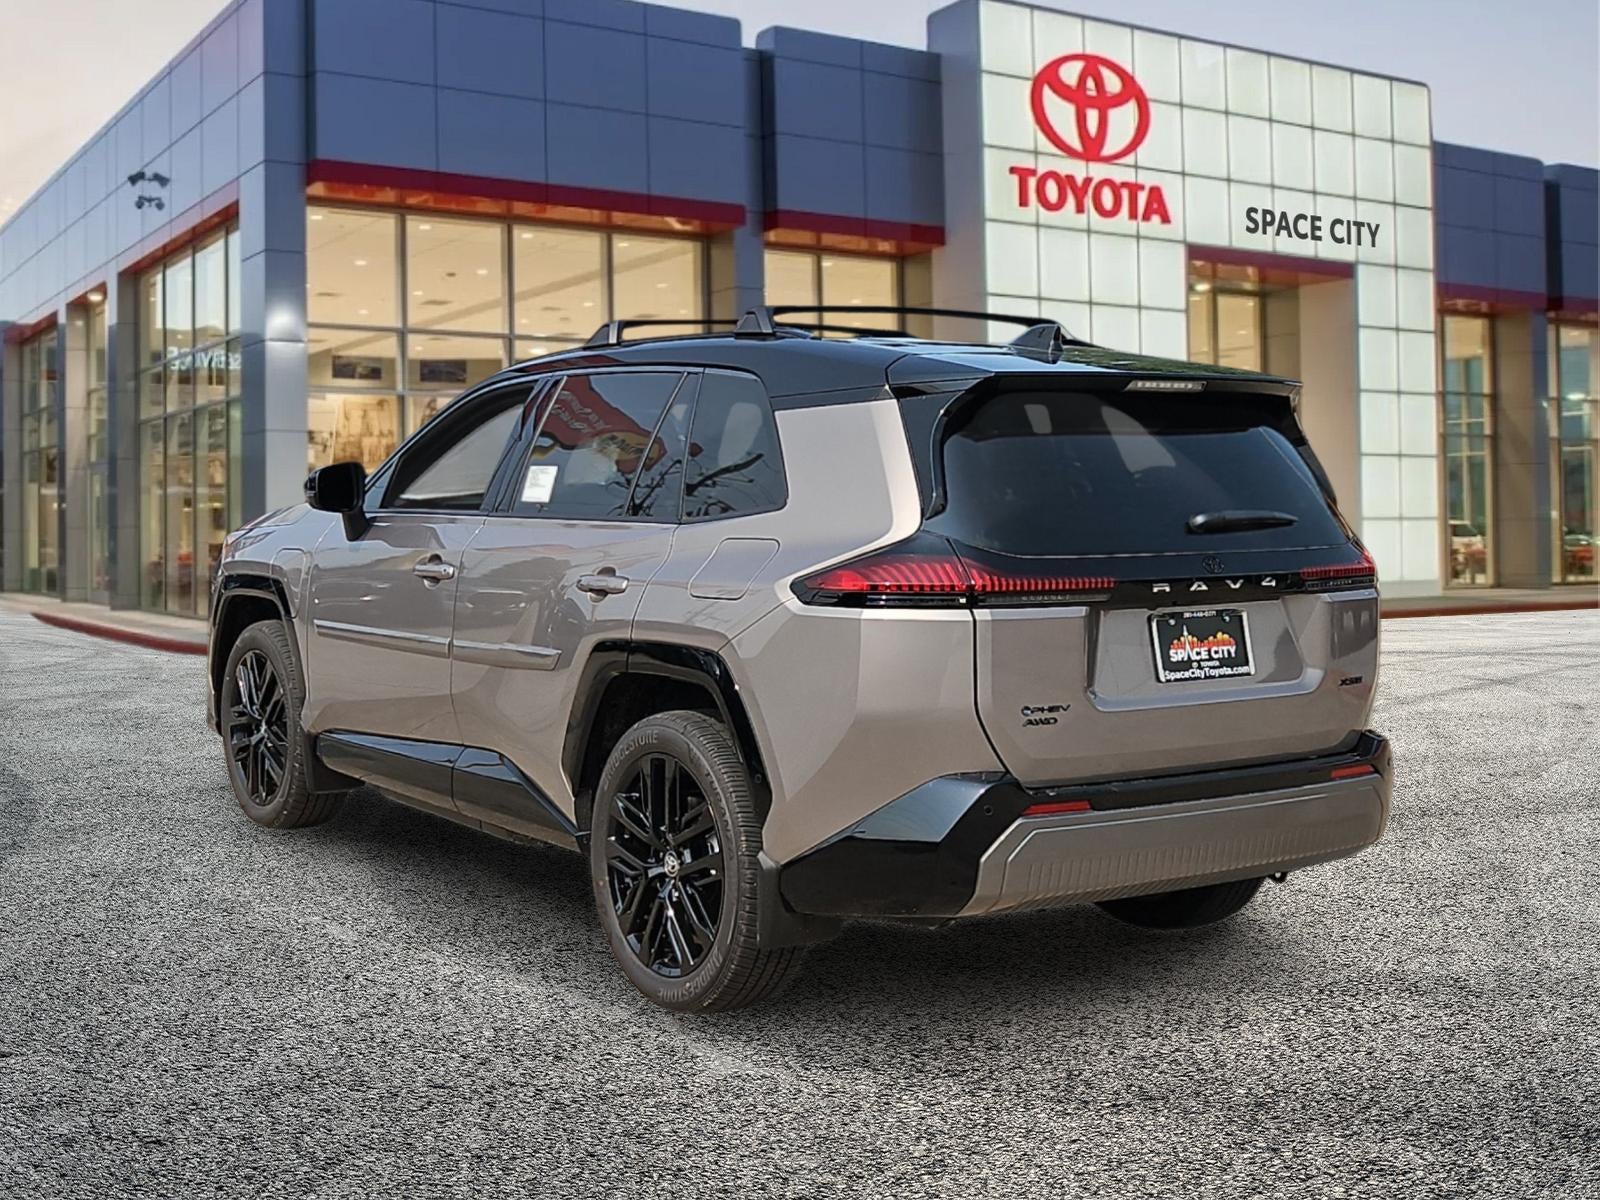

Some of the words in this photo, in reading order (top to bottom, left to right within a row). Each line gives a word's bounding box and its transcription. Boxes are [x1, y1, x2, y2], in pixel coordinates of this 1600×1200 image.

[1009, 166, 1171, 224] TOYOTA
[1245, 206, 1322, 241] SPACE
[1329, 218, 1380, 248] CITY
[1152, 577, 1276, 593] RAV4
[1169, 646, 1209, 662] SPACE
[1210, 645, 1236, 659] CITY
[1200, 660, 1220, 668] TOYOTA
[1165, 665, 1249, 681] SpaceCityToyota.com
[1022, 716, 1058, 727] AWD
